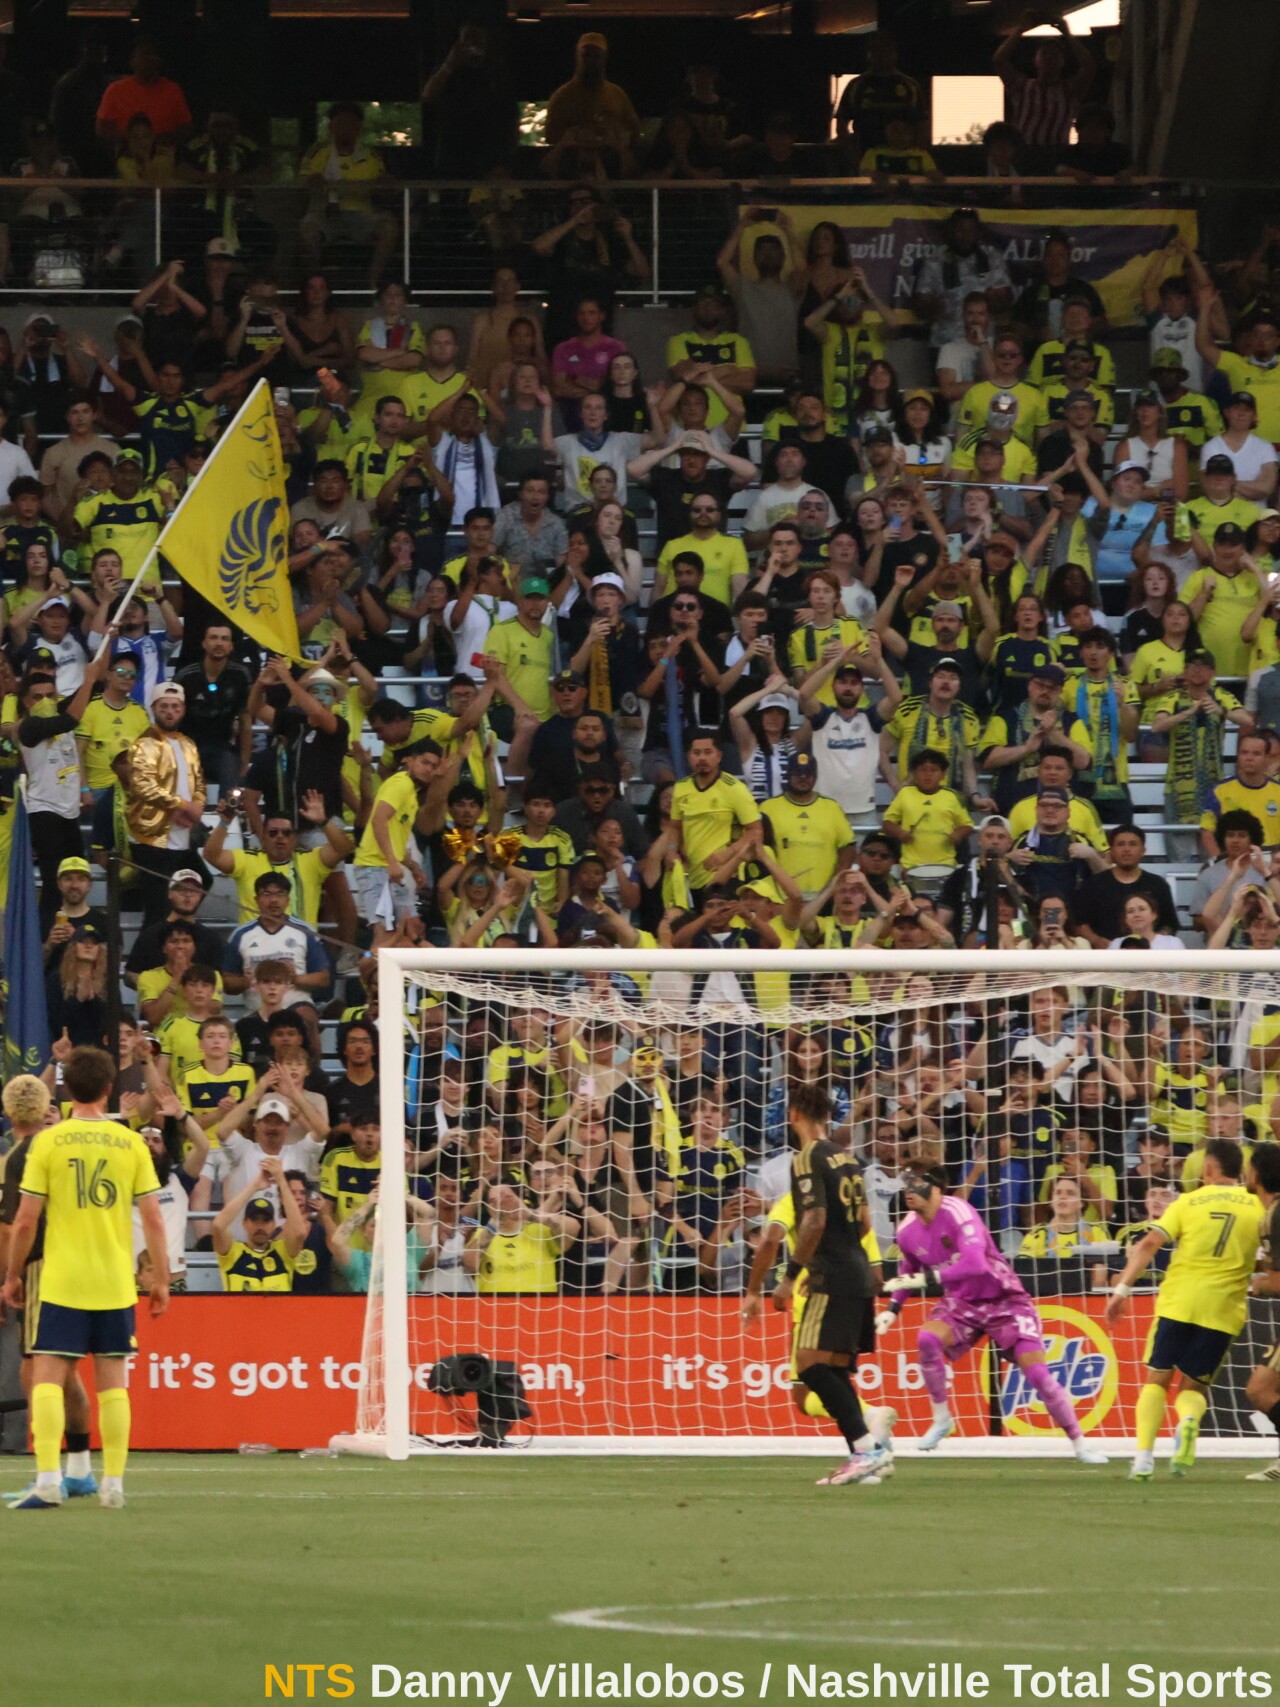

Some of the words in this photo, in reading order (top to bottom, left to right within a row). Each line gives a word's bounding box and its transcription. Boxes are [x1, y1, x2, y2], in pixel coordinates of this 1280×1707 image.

[53, 1131, 132, 1150] CORCORAN
[67, 1157, 118, 1210] 16
[1188, 1191, 1256, 1207] ESPINOZA
[1209, 1211, 1237, 1258] 7
[149, 1353, 217, 1390] it's
[229, 1356, 308, 1396] got
[319, 1356, 371, 1390] to
[663, 1354, 730, 1391] it's
[743, 1362, 797, 1398] go
[856, 1362, 883, 1390] o
